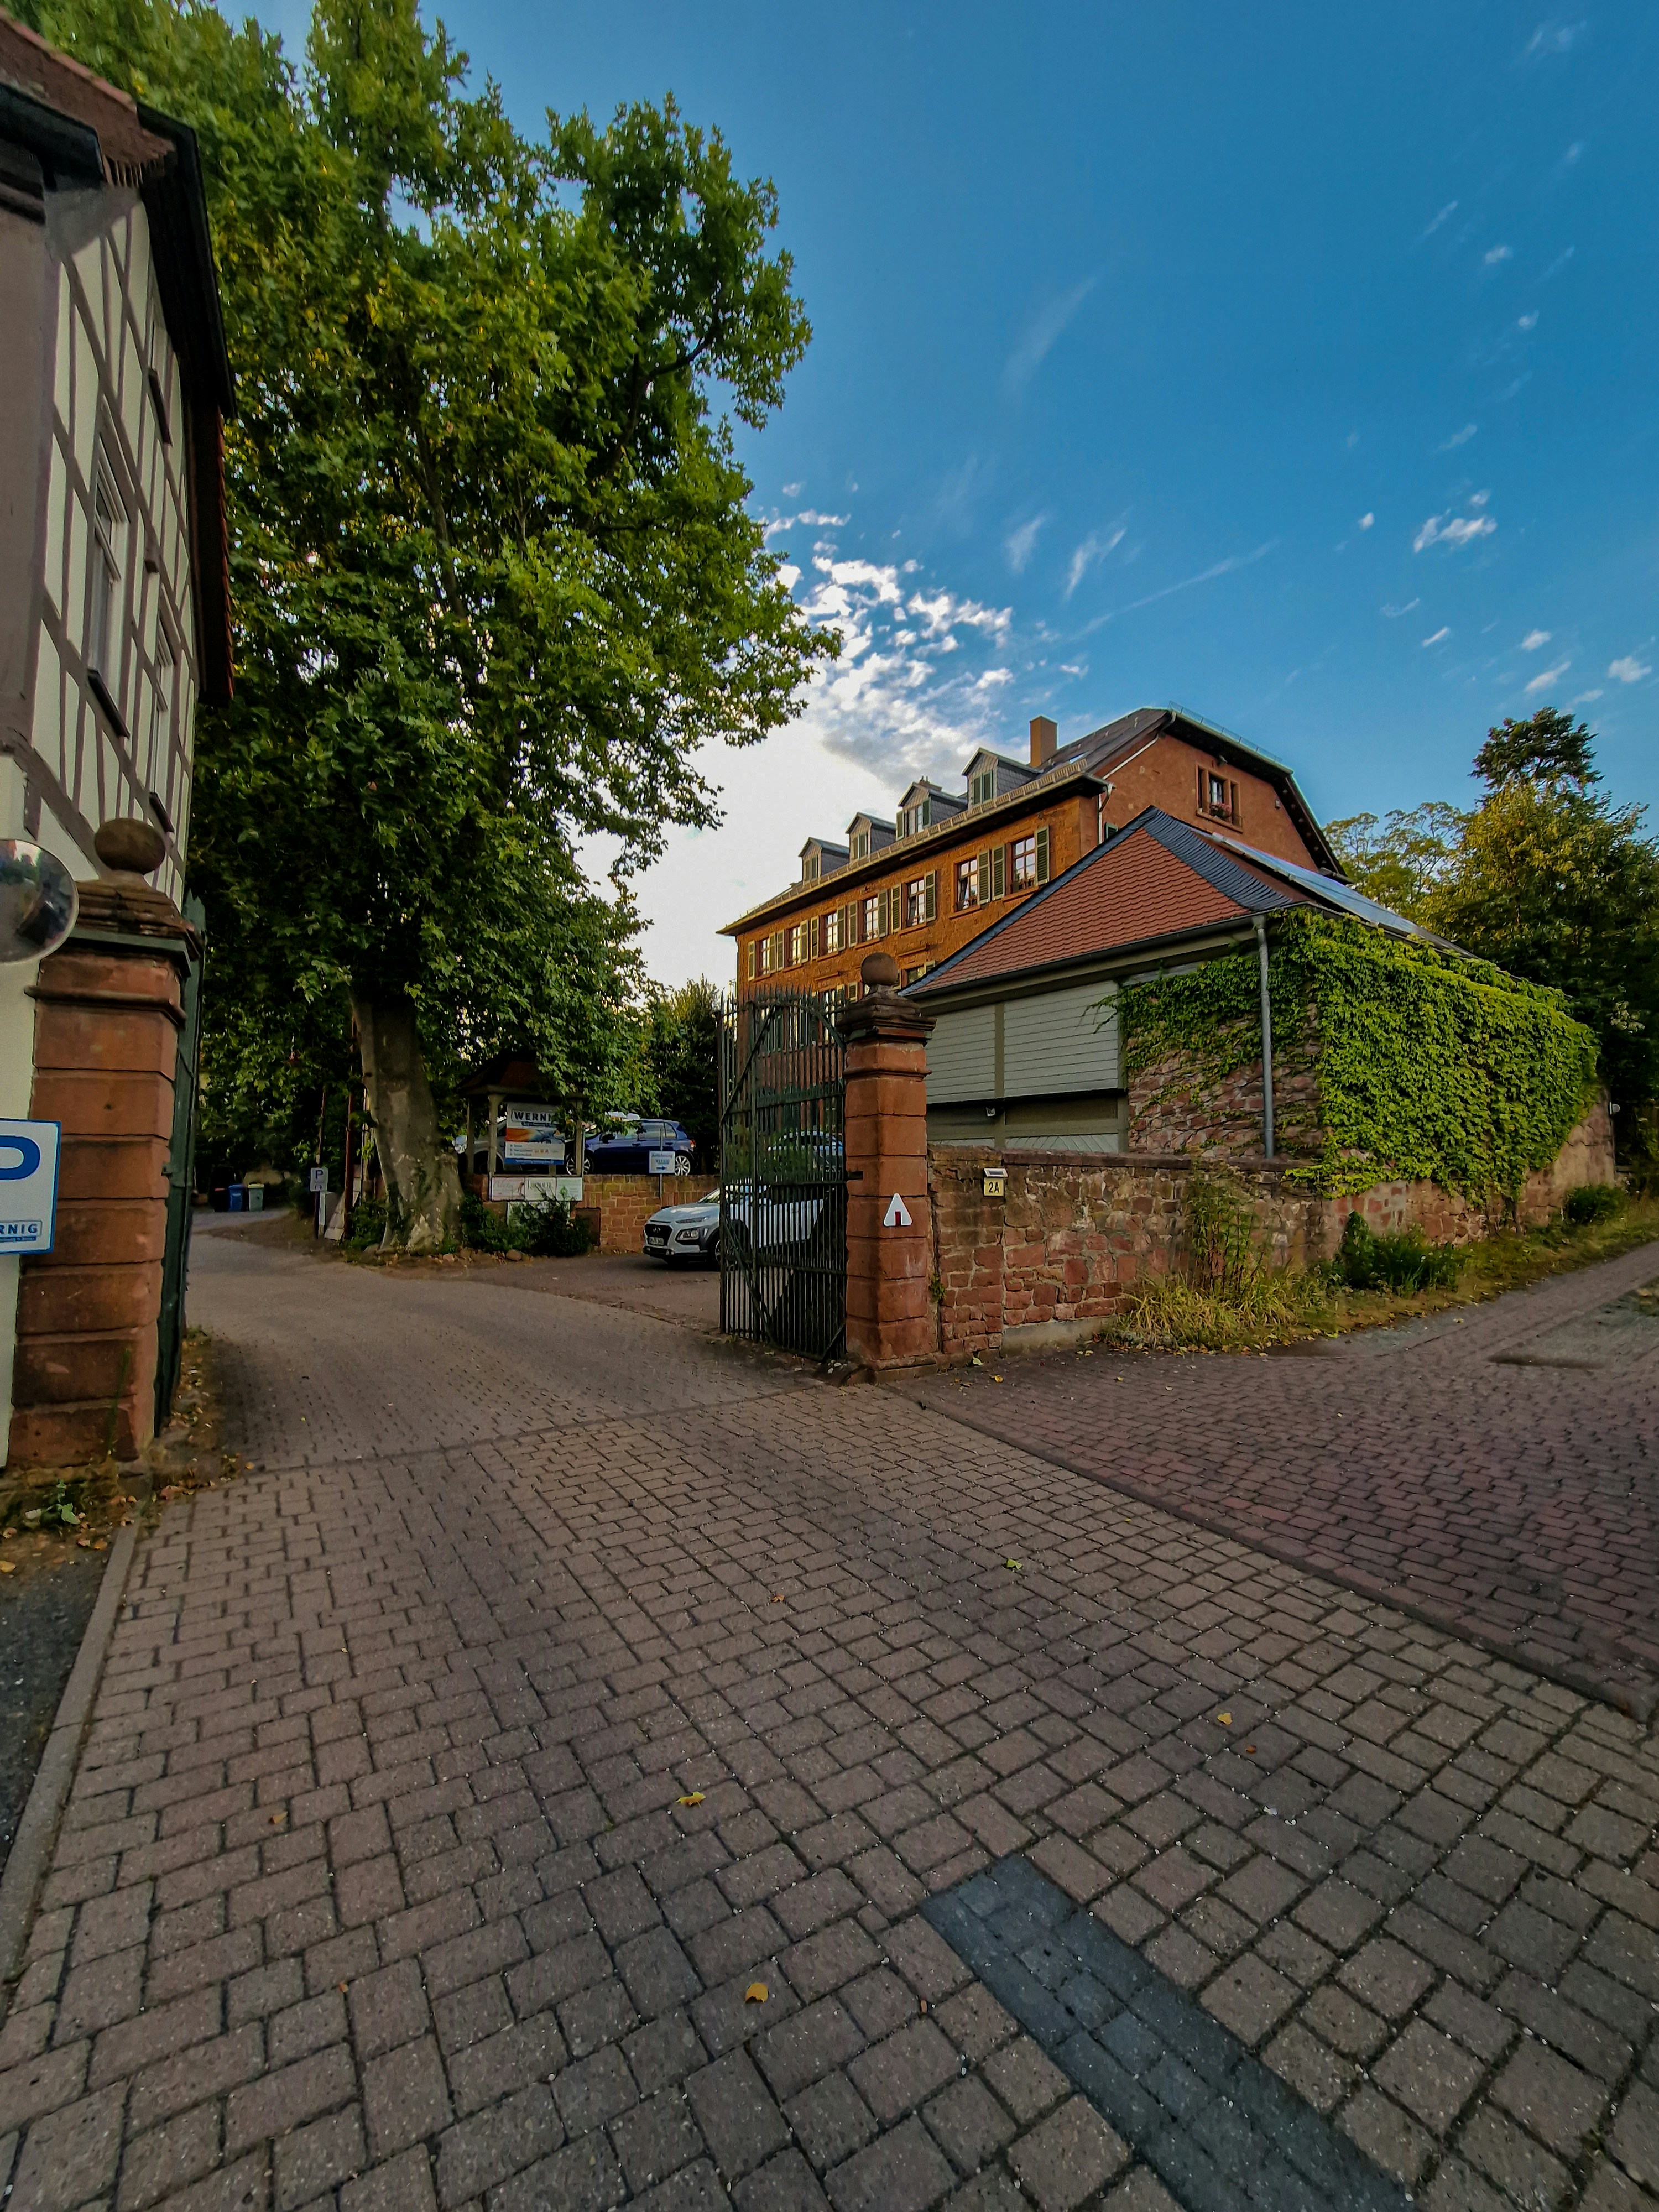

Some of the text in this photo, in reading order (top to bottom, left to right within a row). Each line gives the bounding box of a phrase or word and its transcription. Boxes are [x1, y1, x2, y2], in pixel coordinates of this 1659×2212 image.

[514, 1112, 552, 1121] WERNI
[315, 1170, 324, 1179] P
[989, 1181, 999, 1193] 2A
